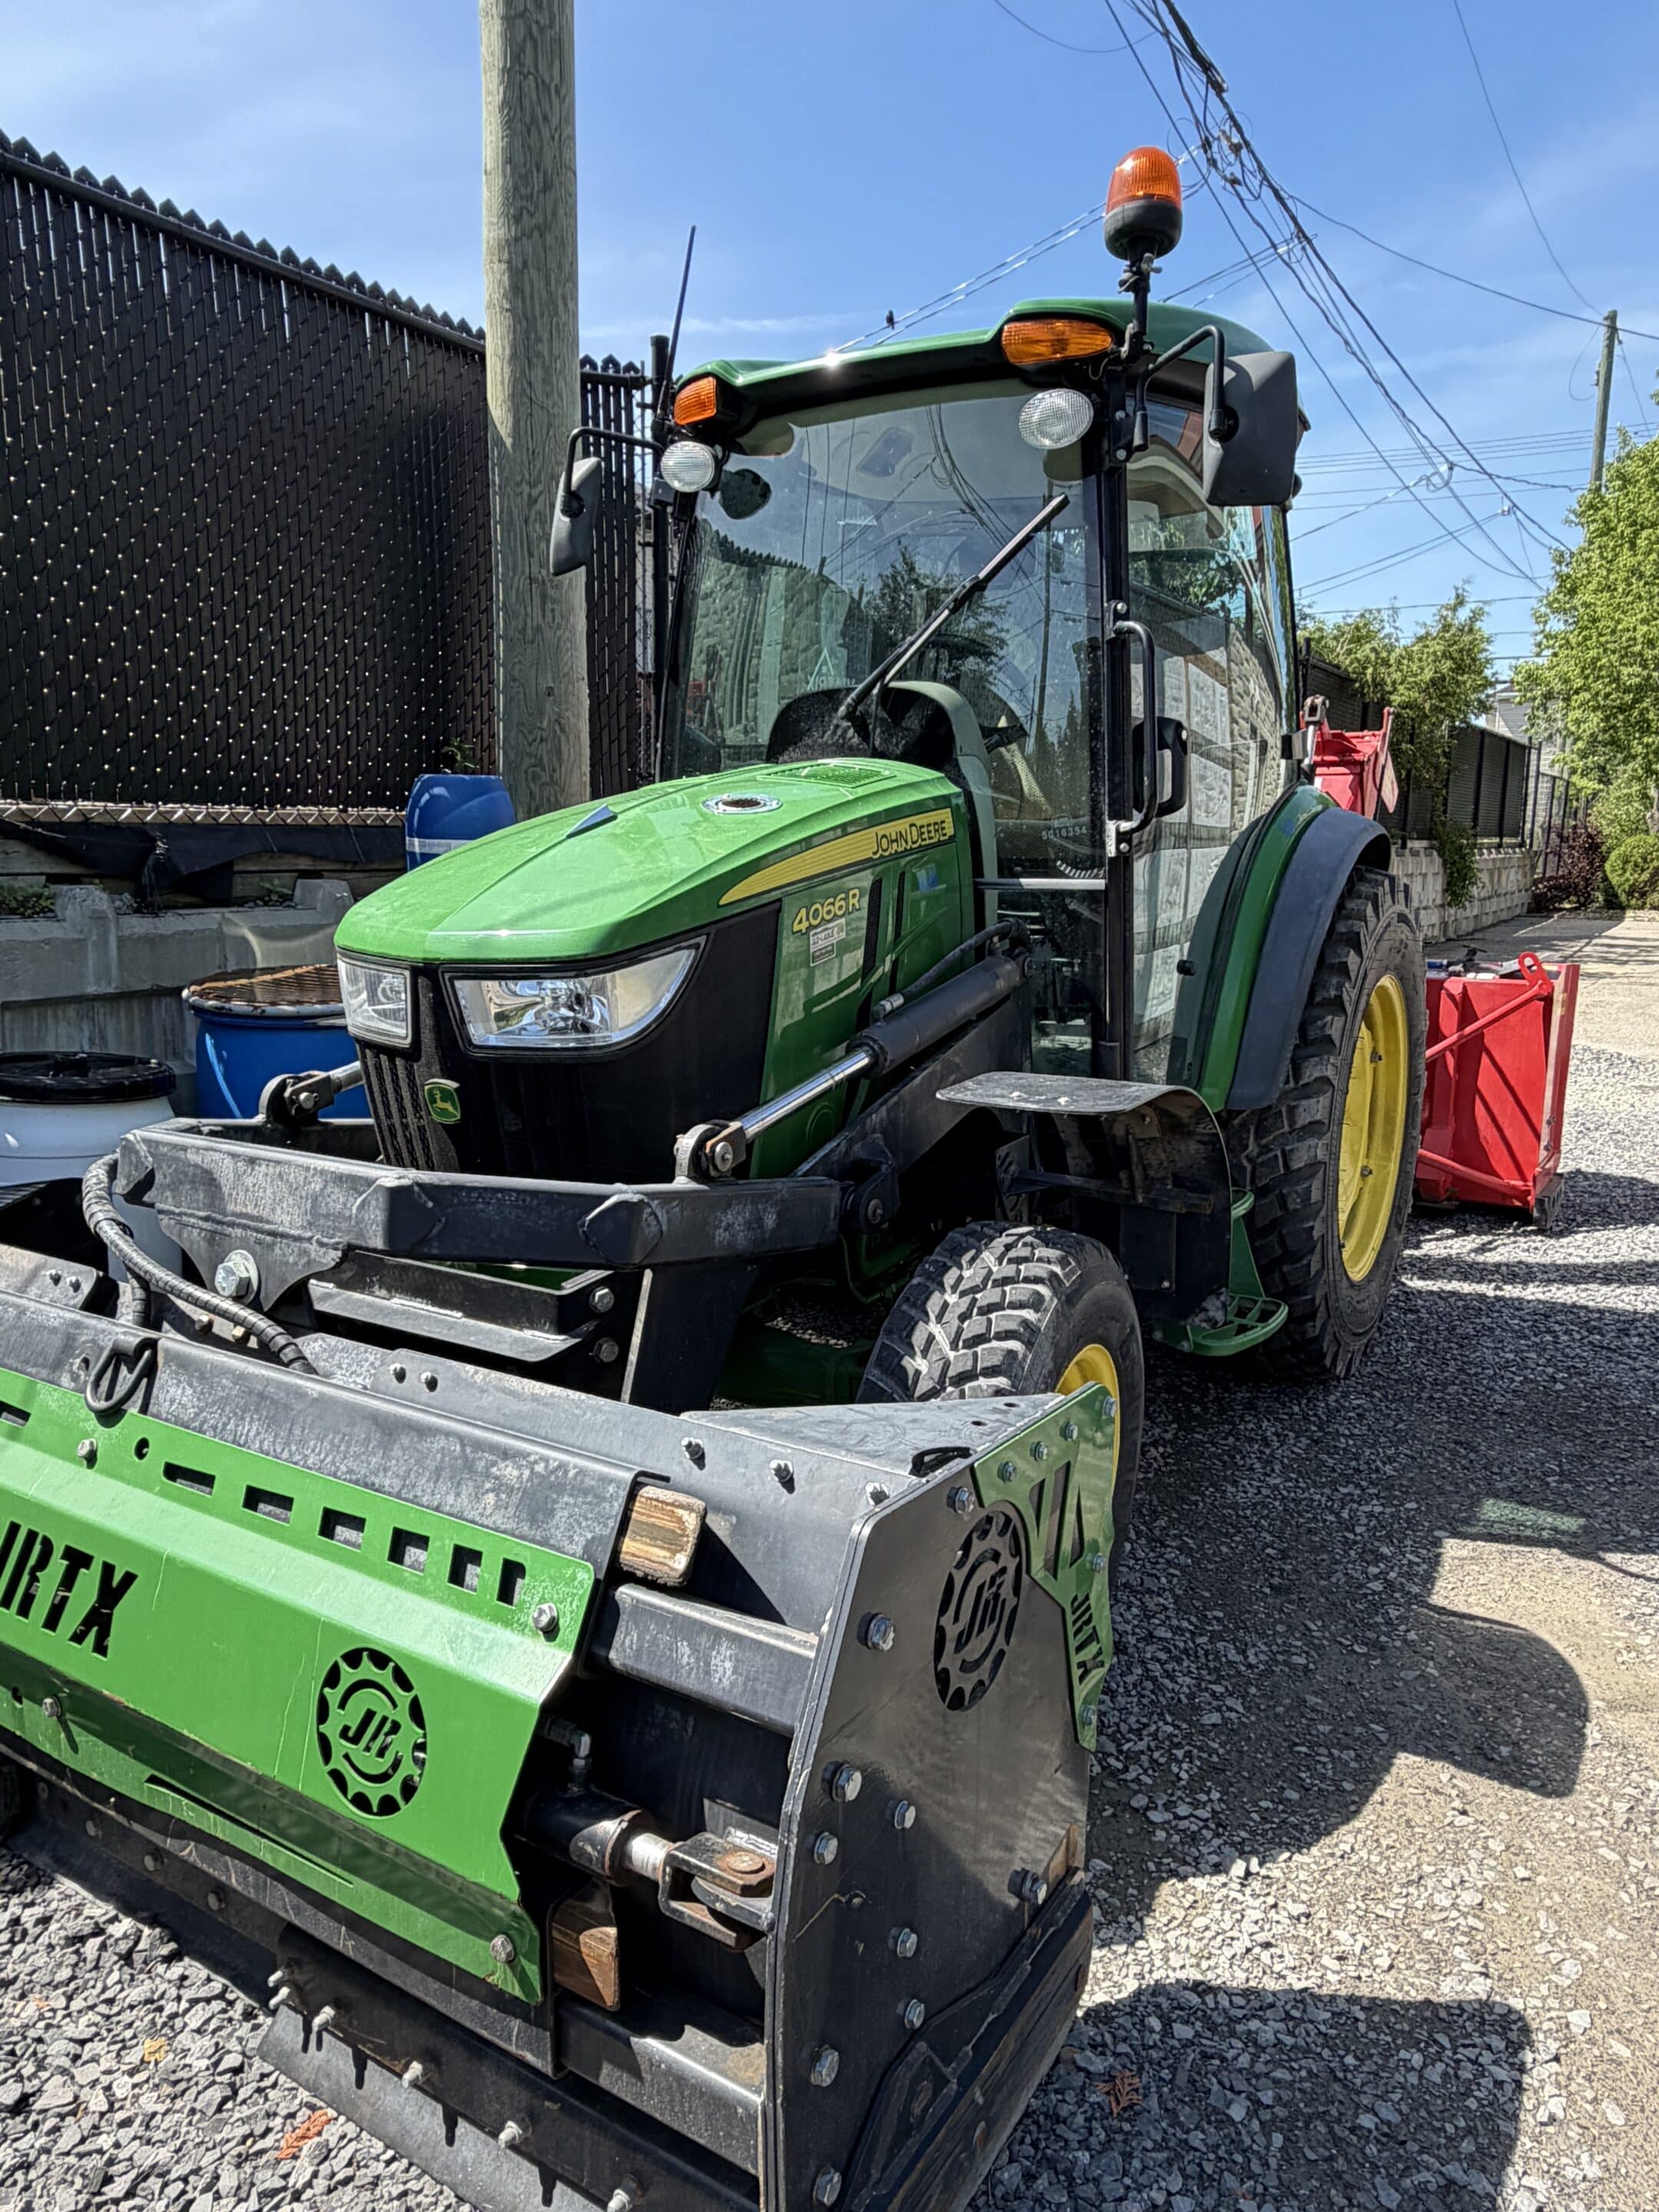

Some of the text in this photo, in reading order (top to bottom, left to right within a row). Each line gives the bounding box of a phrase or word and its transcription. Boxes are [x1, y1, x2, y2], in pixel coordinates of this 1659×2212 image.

[872, 820, 948, 856] JOHN DEERE
[792, 887, 860, 935] 4066R
[1070, 1592, 1104, 1686] JRTX
[338, 1707, 402, 1761] JR
